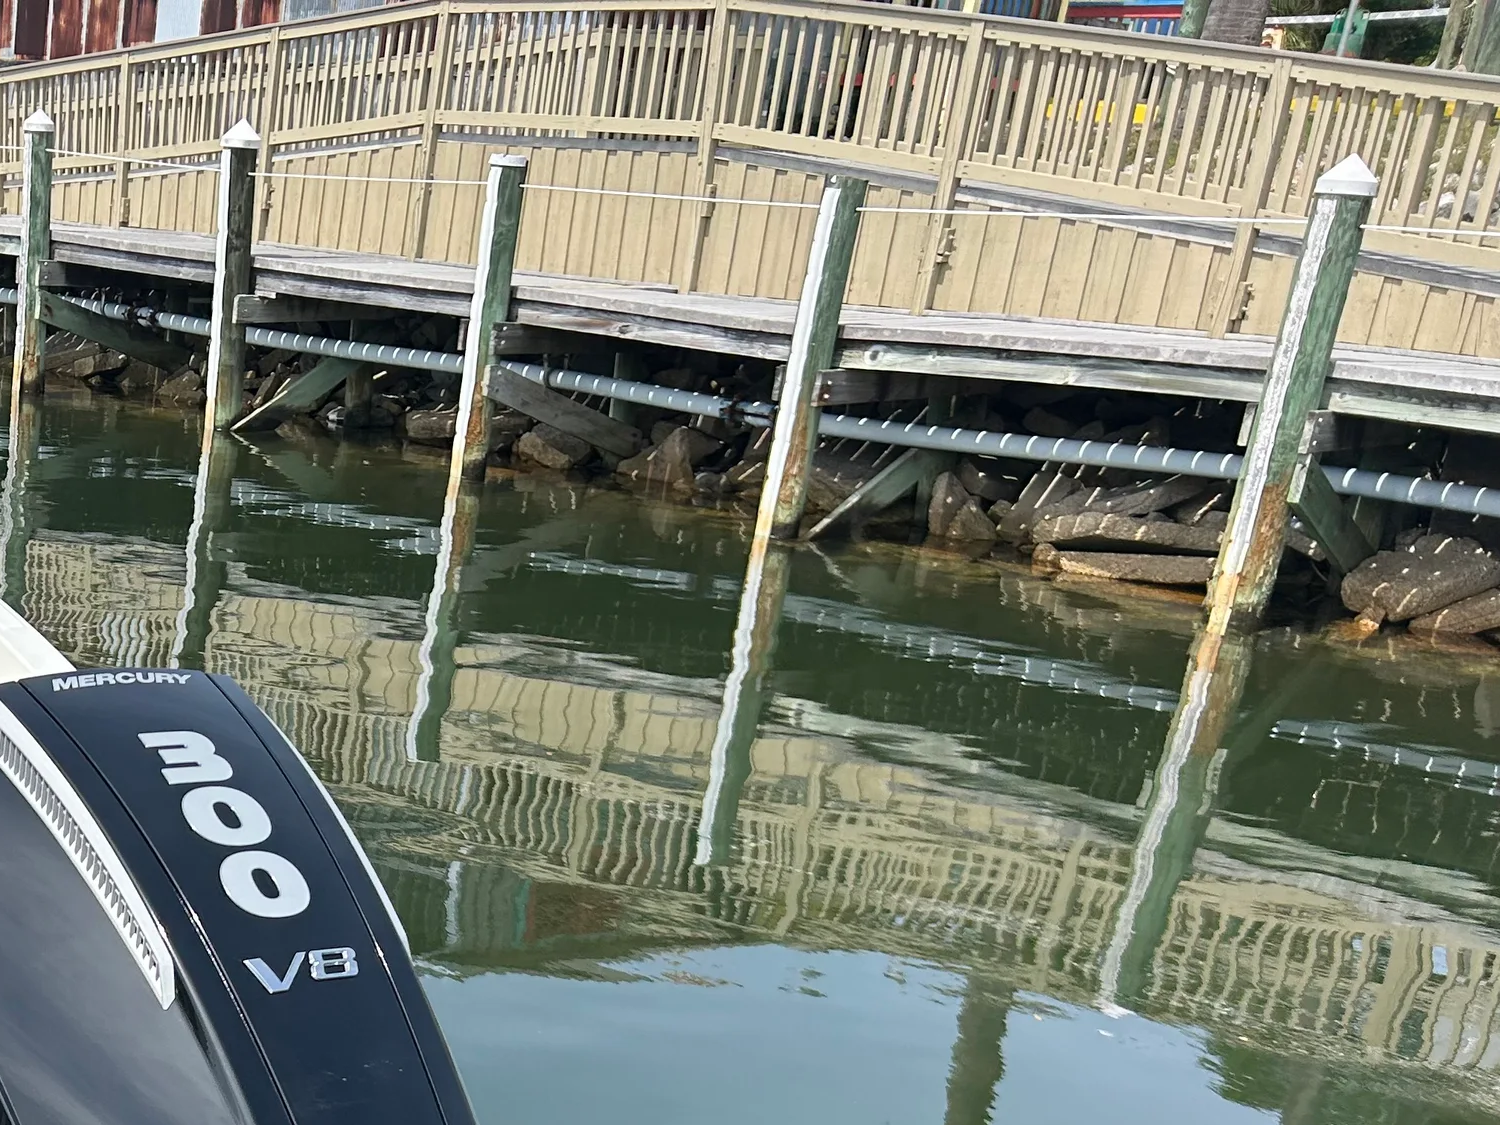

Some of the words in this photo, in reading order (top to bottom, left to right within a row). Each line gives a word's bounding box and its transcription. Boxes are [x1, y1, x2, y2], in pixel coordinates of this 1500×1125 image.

[52, 671, 192, 692] MERCURY
[137, 730, 311, 918] 300
[243, 946, 359, 994] V8
